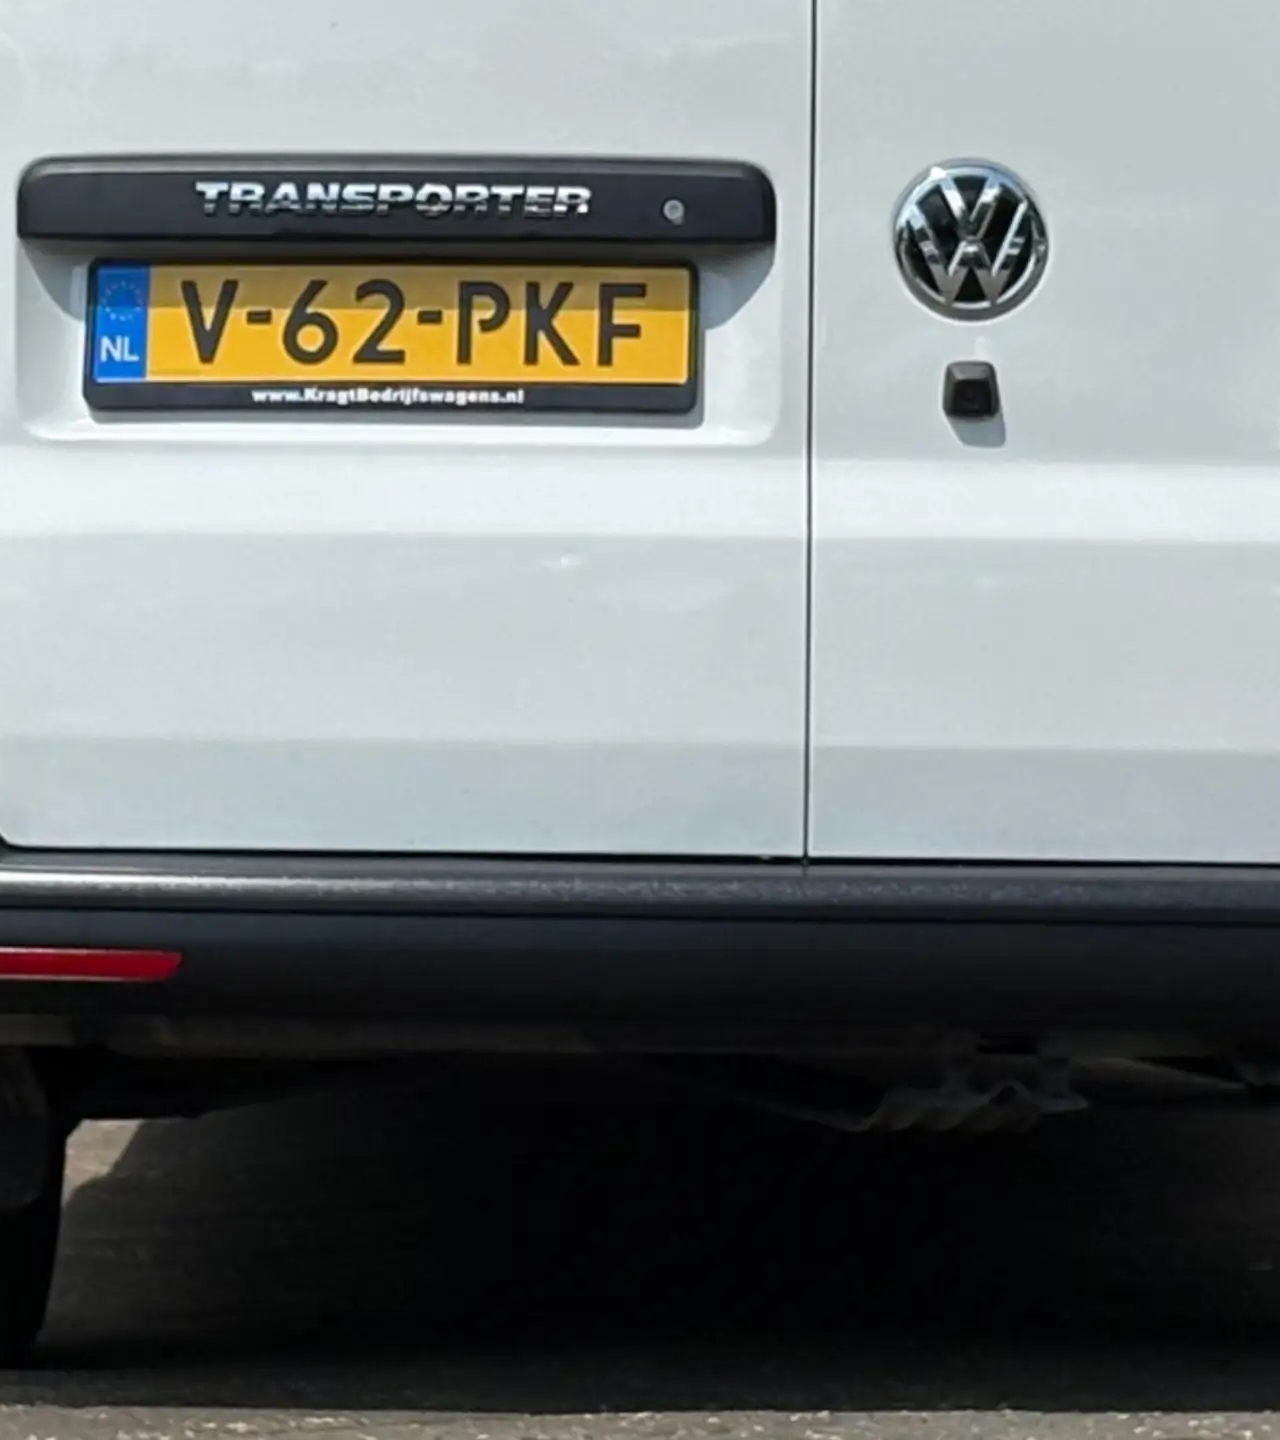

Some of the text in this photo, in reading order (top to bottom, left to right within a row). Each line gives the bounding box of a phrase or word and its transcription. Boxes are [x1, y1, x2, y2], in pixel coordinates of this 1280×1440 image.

[195, 181, 593, 217] TRANSPORTER
[180, 279, 648, 368] V-62-PKF
[100, 335, 140, 362] NL
[251, 387, 525, 406] www.KragtBedrijfswagens.nl
